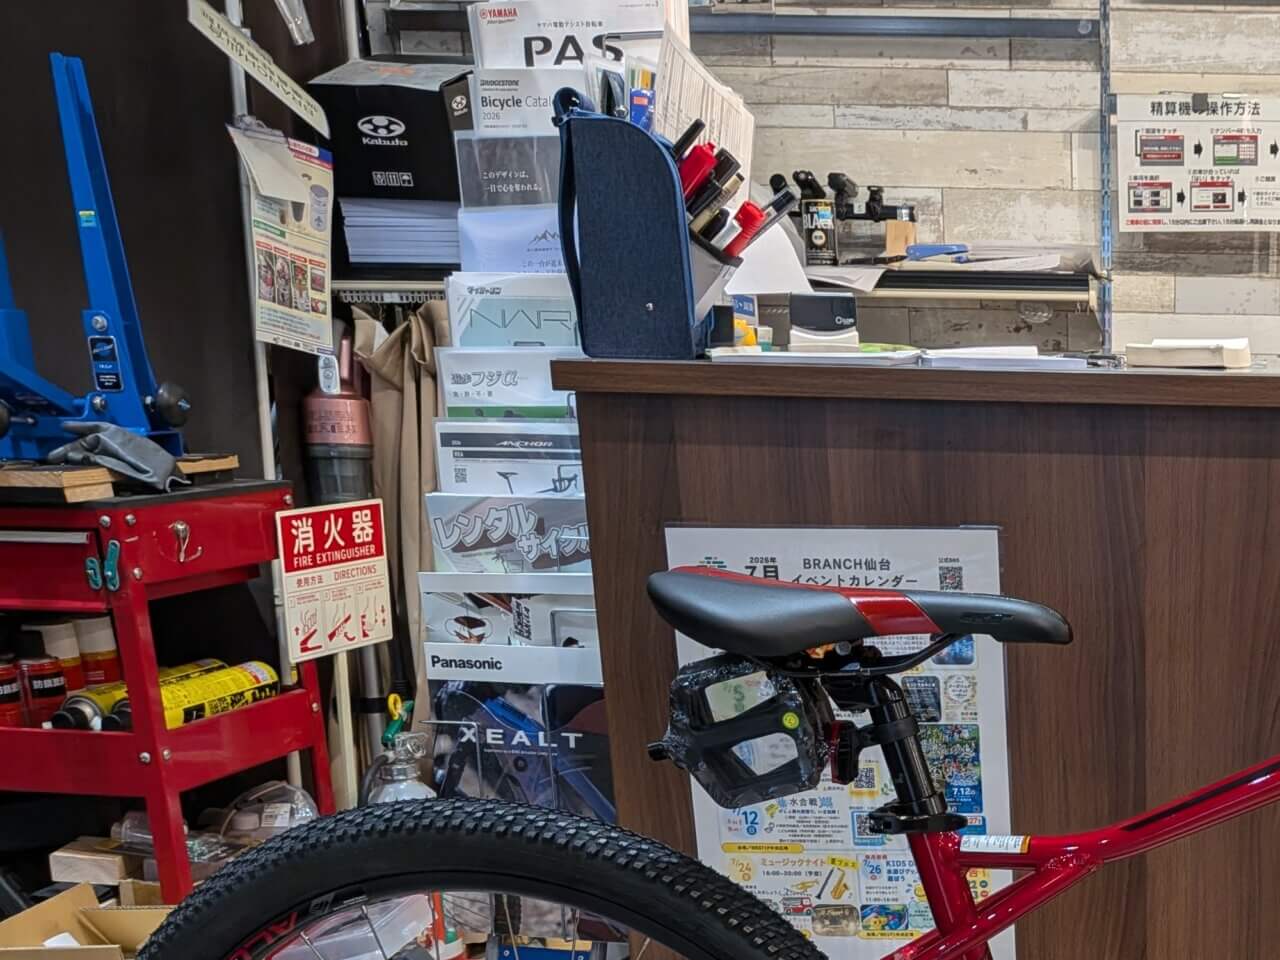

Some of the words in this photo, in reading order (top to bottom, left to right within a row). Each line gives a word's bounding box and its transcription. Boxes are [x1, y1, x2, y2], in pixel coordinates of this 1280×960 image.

[488, 8, 518, 18] YAMAHA
[523, 34, 624, 67] PAS
[481, 96, 522, 110] Bicycle
[1150, 101, 1261, 116] 精算機操作方法
[482, 112, 501, 120] 2026
[362, 137, 408, 146] Kabuto
[291, 509, 374, 555] 消火器
[433, 503, 537, 549] レンタル
[293, 556, 313, 568] FIRE
[316, 544, 376, 564] EXTINGUISHER
[803, 558, 891, 571] BRANCH仙台
[296, 575, 324, 589] 使用方法
[334, 564, 377, 581] DIRECTIONS
[792, 574, 917, 587] イベントカレンダー
[431, 656, 503, 671] Panasonic
[460, 727, 583, 749] XEALT
